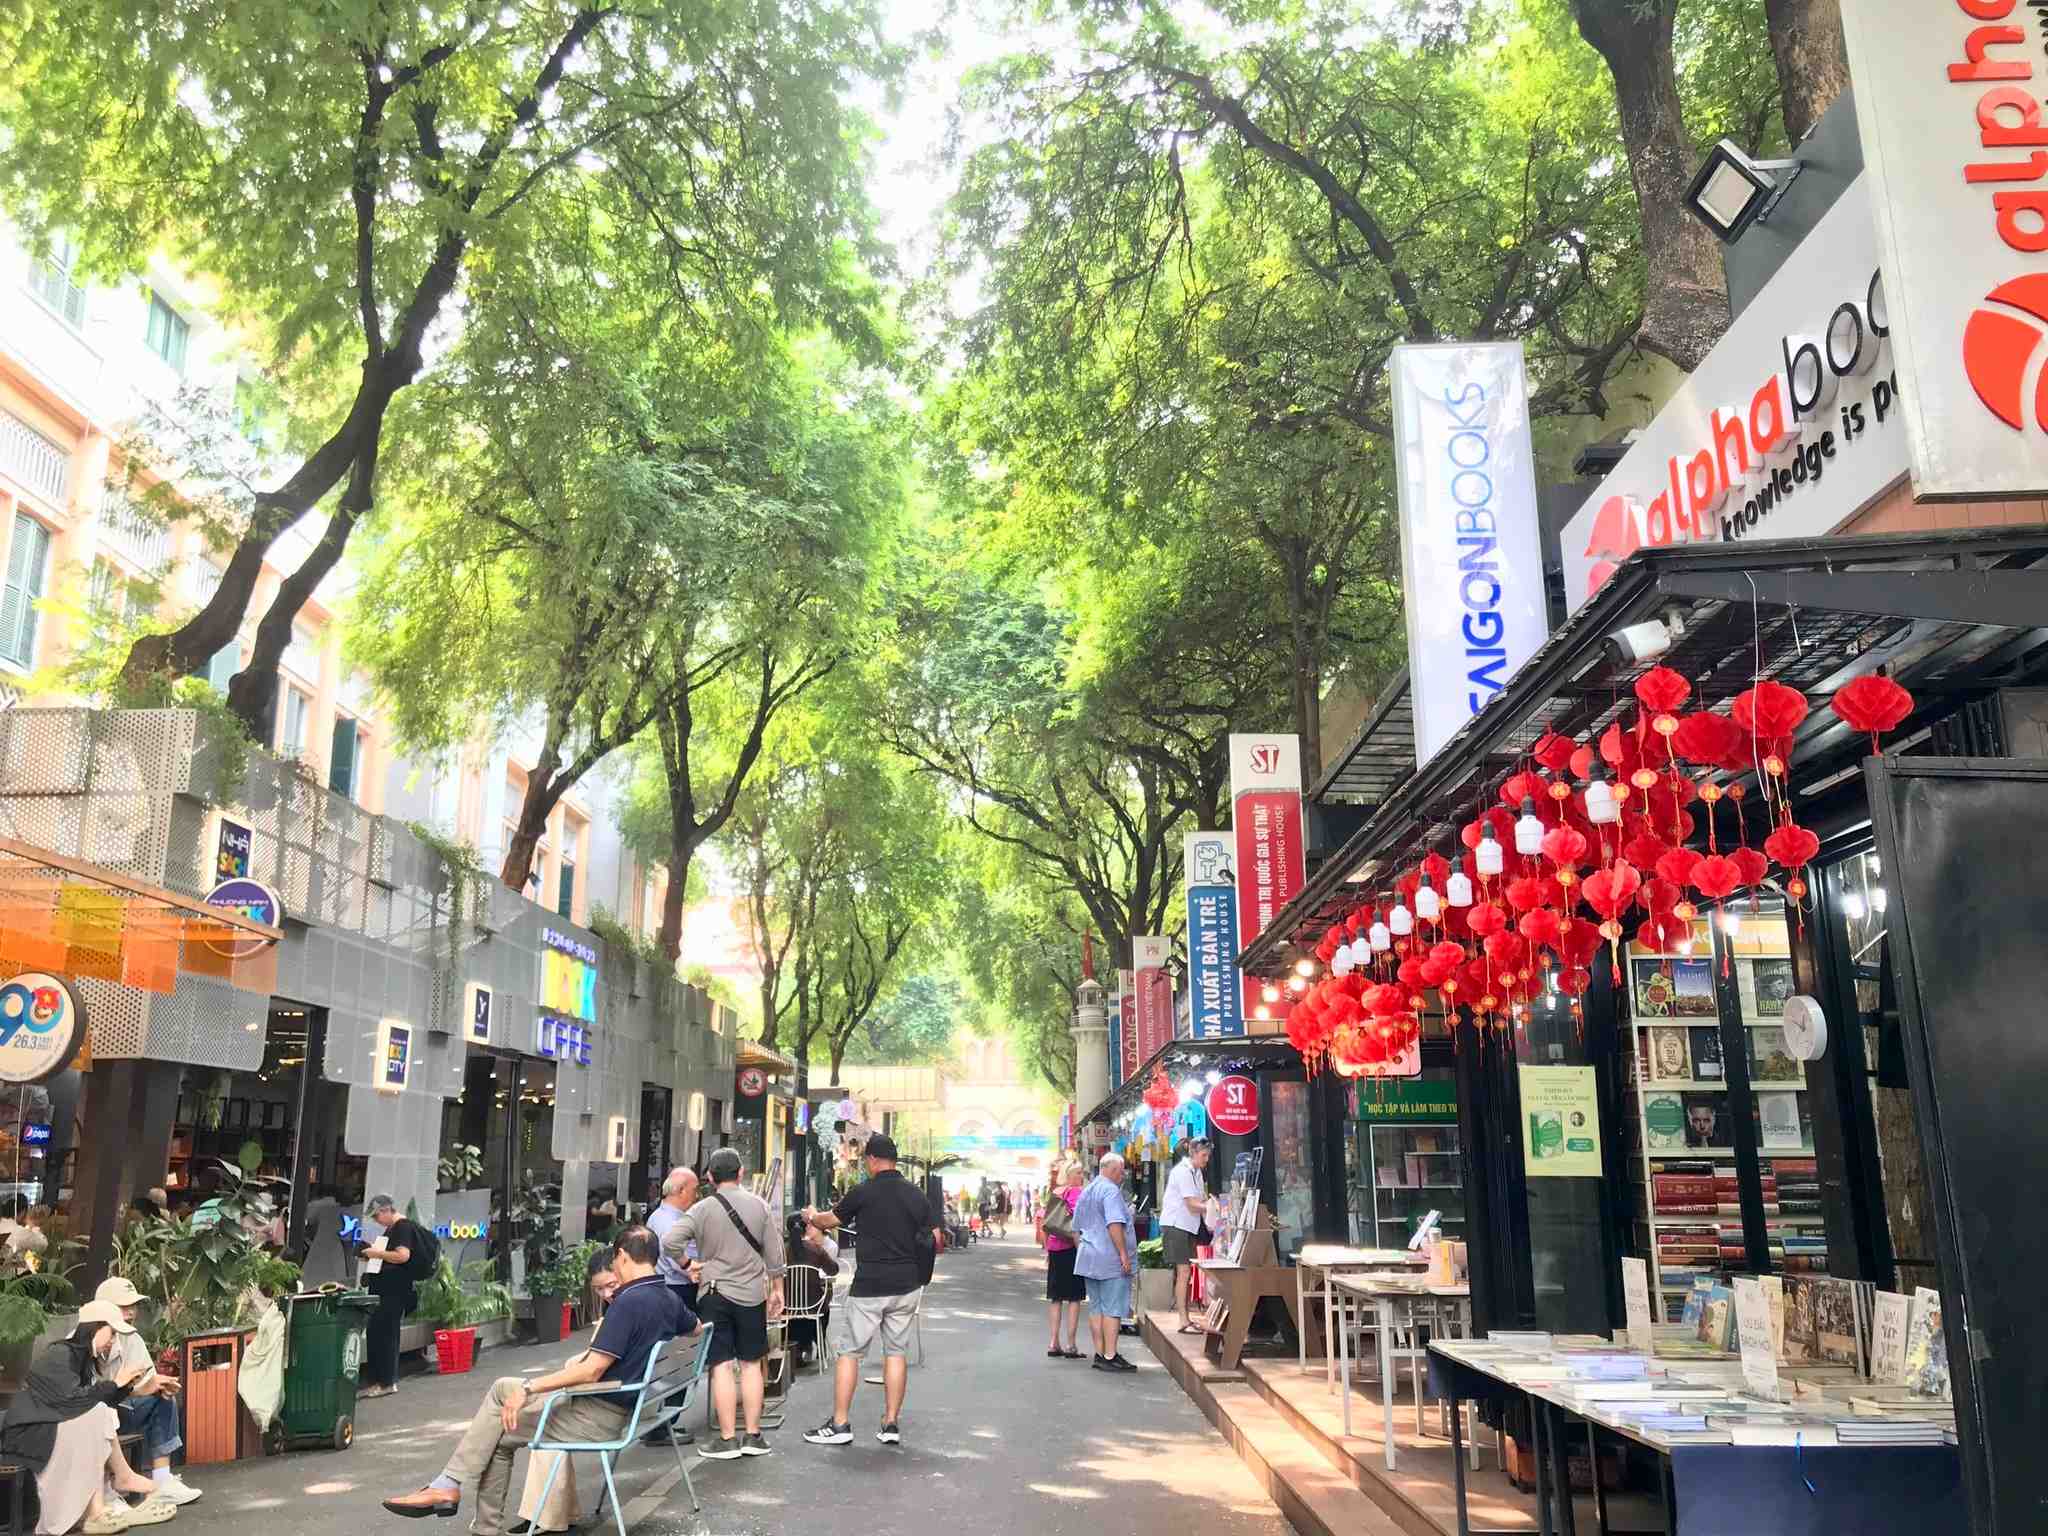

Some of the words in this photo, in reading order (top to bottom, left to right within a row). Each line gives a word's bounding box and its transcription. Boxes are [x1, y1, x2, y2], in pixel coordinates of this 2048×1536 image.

[1721, 429, 1837, 542] knowledge
[1840, 401, 1865, 441] is
[1251, 745, 1279, 774] ST
[1273, 804, 1285, 837] HOUSE
[1256, 843, 1270, 858] GIA
[1275, 839, 1289, 897] PUBLISHING
[1218, 895, 1230, 934] HOUSE
[1196, 968, 1221, 1010] XUẤT
[1221, 941, 1233, 1018] PUBLISHING
[1226, 1083, 1247, 1105] ST
